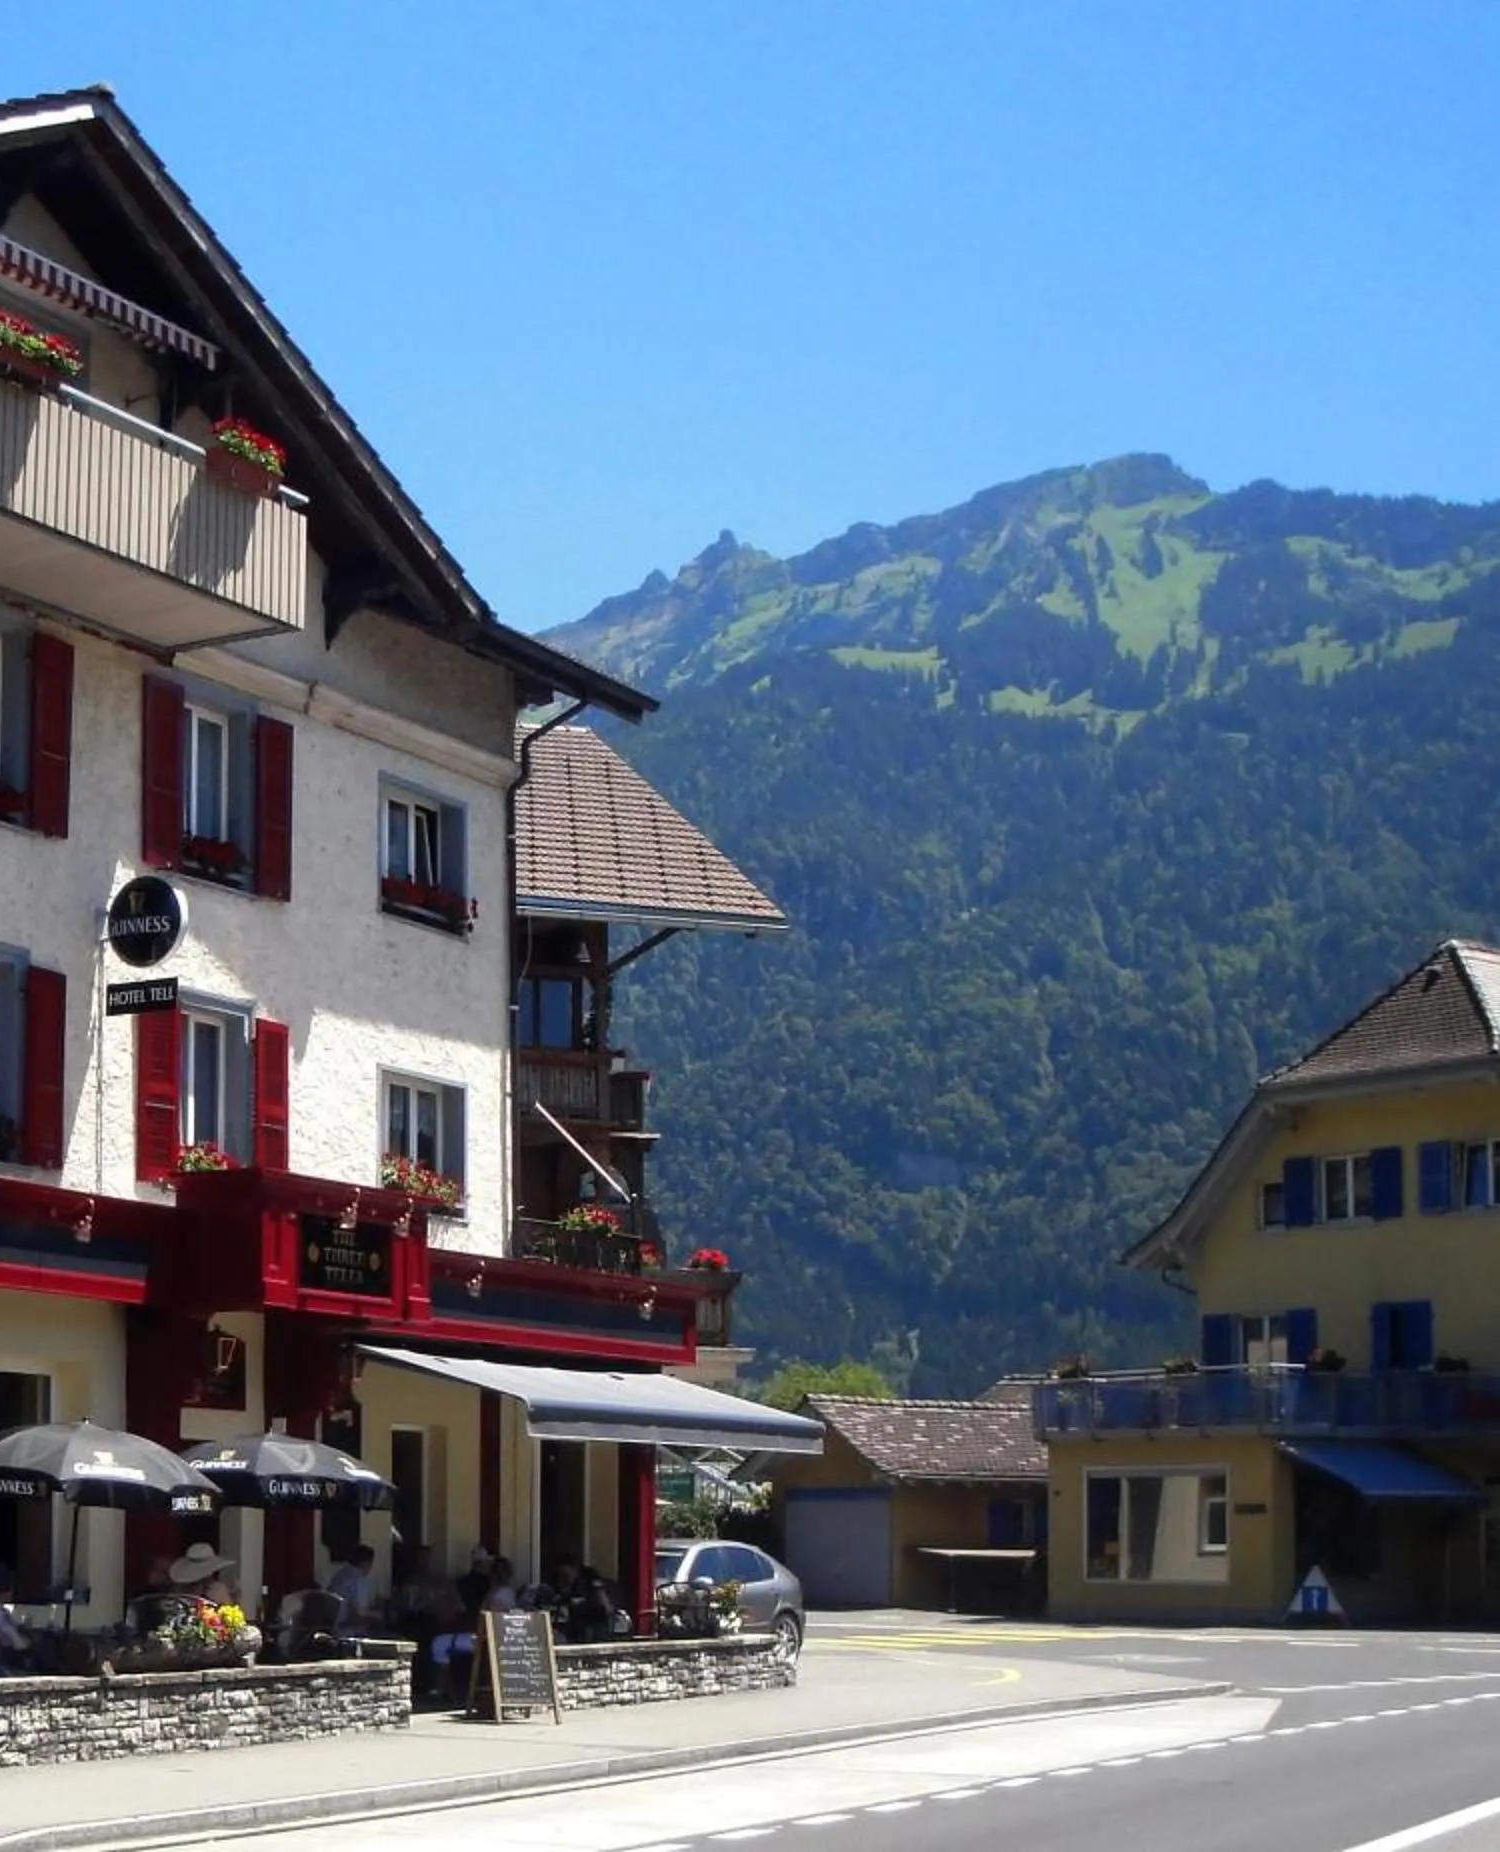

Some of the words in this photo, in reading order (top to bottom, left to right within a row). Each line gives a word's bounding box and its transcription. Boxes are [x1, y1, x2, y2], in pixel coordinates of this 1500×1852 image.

[110, 915, 171, 937] GUINNESS
[109, 988, 146, 1006] HOTEL
[151, 986, 174, 1002] TELL
[269, 1480, 321, 1496] GUINNESS
